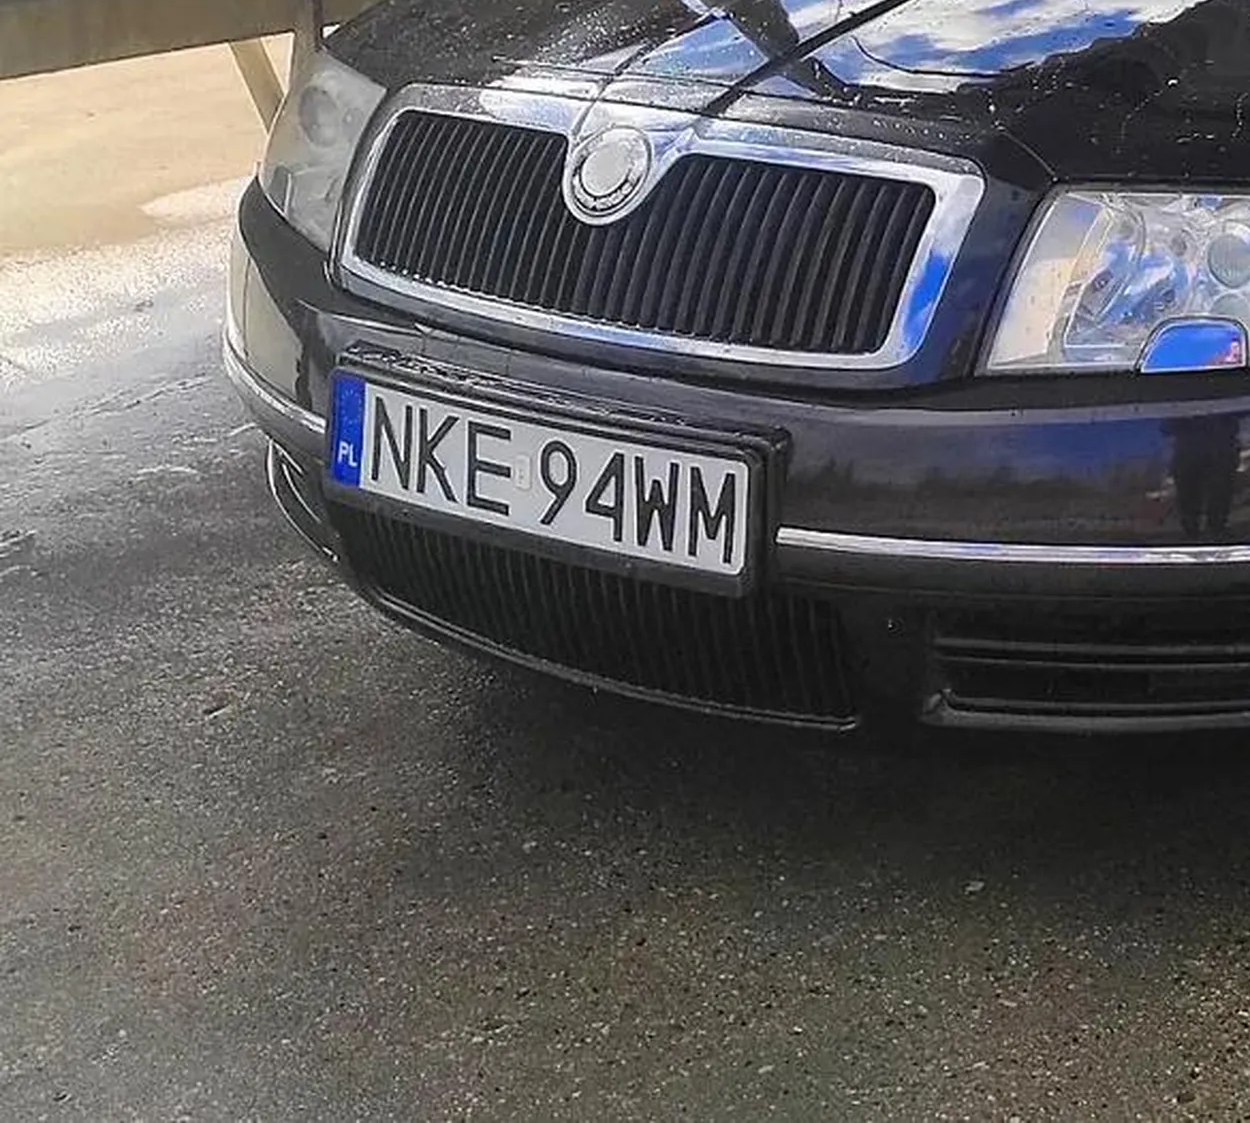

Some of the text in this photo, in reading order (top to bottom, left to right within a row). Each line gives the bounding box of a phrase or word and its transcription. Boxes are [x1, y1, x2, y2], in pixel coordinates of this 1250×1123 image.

[337, 441, 359, 467] PL
[371, 395, 736, 564] NKE 94WM
